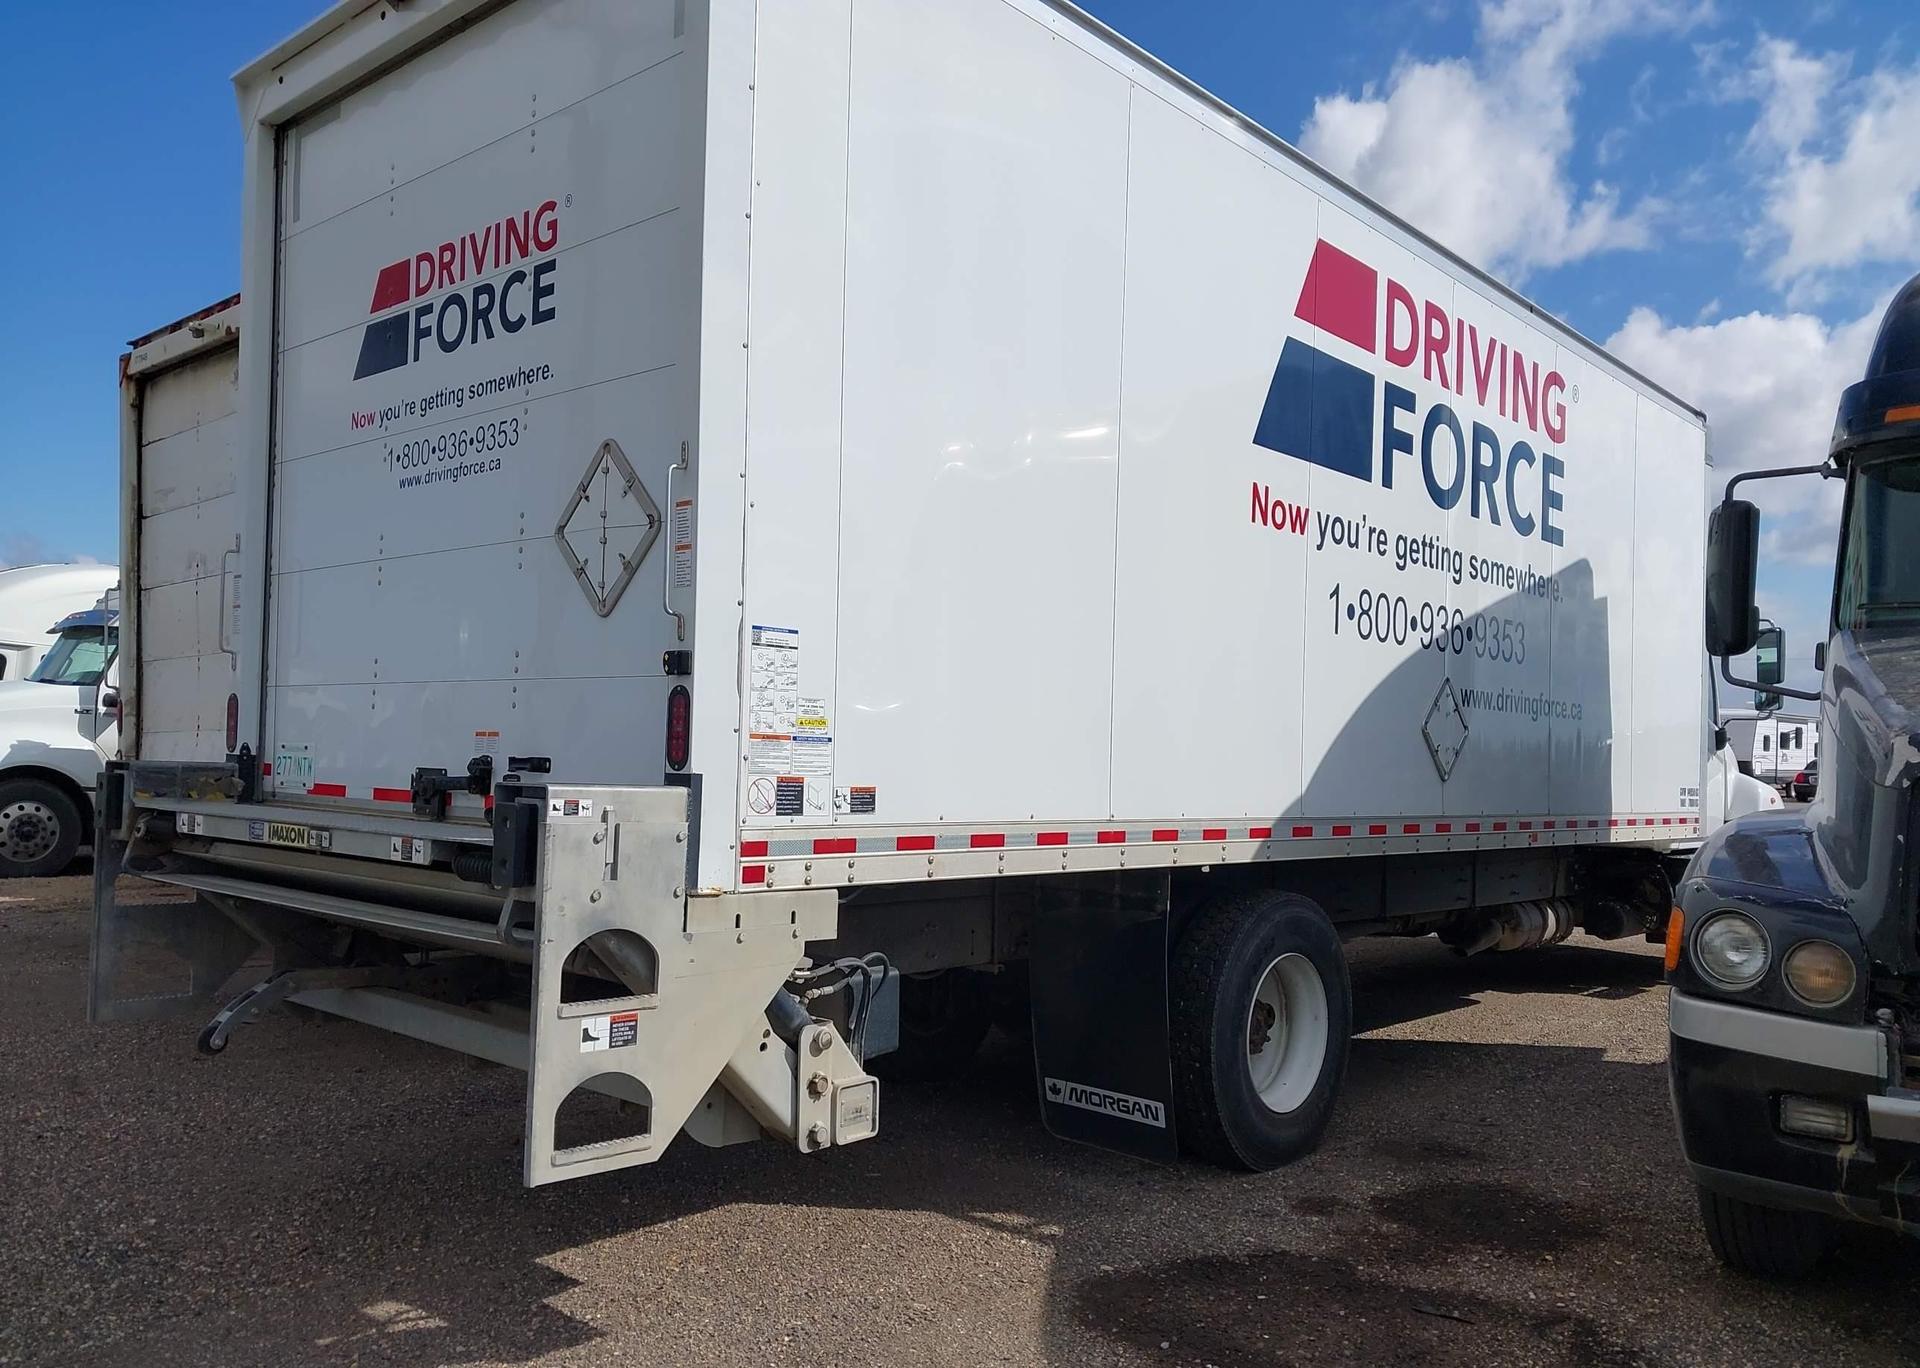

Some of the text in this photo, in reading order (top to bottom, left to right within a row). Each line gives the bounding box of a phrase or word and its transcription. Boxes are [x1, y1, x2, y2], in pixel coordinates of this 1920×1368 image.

[414, 199, 559, 298] DRIVING
[412, 257, 558, 363] FORCE
[1384, 276, 1567, 445] DRIVING
[351, 363, 555, 431] Now you're getting somewhere.
[399, 456, 502, 490] www.drivingforce.ca
[1381, 379, 1565, 548] FORCE
[1250, 481, 1564, 604] Now you're getting somewhere.
[1459, 686, 1584, 722] www.drivingforce.ca
[276, 755, 293, 777] 277
[271, 824, 305, 844] MAXON
[1068, 1086, 1160, 1122] MORGAN
